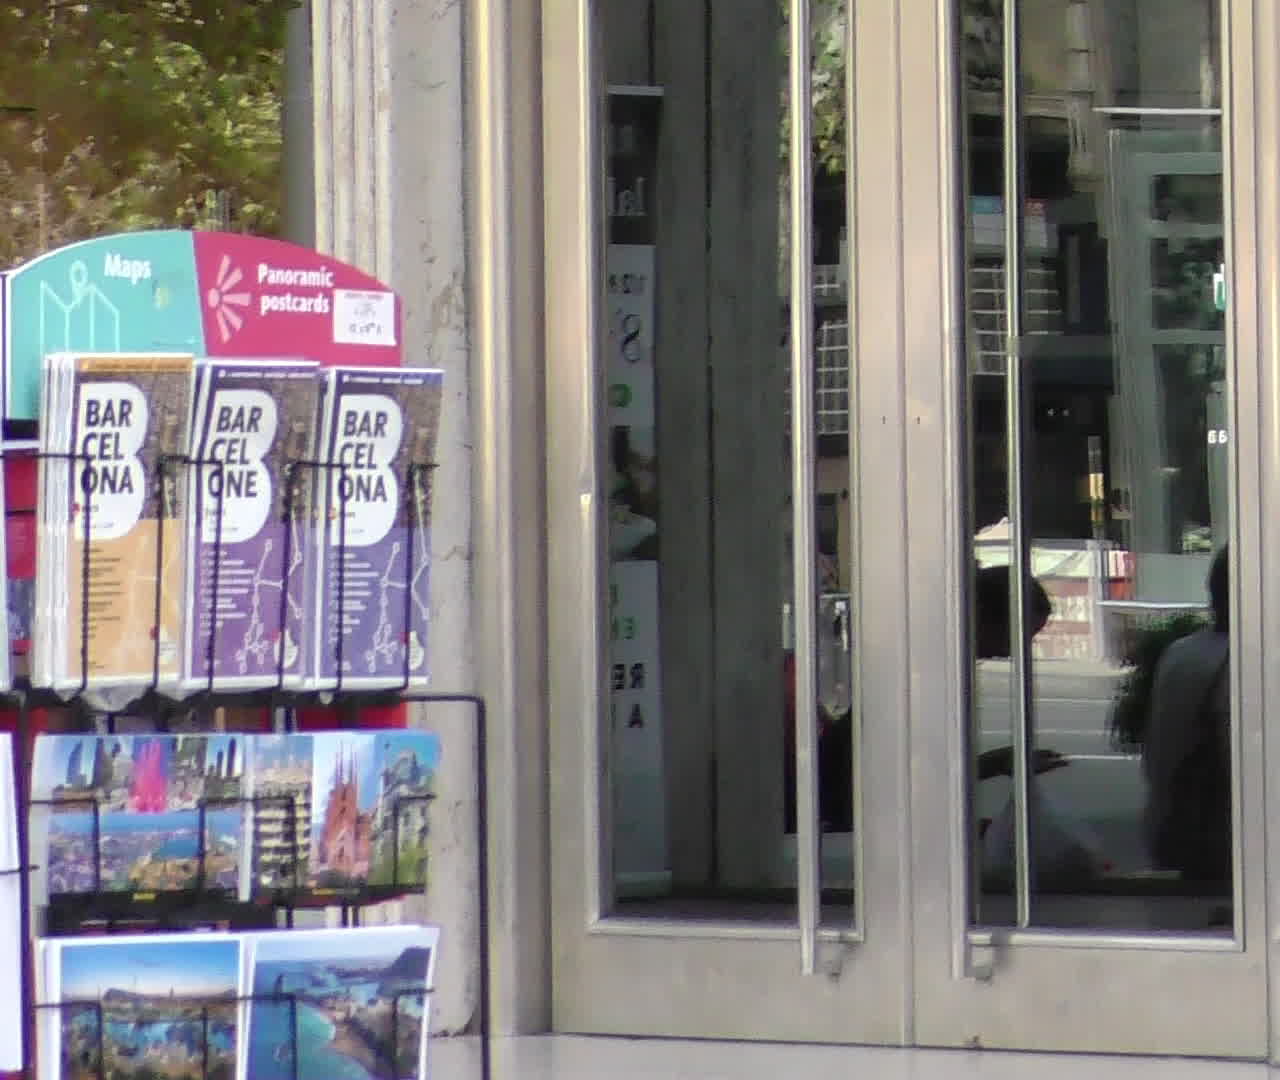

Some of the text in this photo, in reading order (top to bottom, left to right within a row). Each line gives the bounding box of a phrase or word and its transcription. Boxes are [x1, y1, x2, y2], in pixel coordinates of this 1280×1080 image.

[103, 252, 152, 285] Maps
[257, 263, 334, 288] Panoramic
[260, 293, 329, 316] postcards
[85, 399, 133, 428] BAR
[216, 405, 263, 433] BAR
[343, 410, 388, 438] BAR
[82, 431, 125, 461] CEL
[210, 437, 251, 465] CEL
[340, 442, 377, 470] CEL
[81, 466, 134, 495] ONA
[207, 470, 258, 499] ONE
[338, 475, 388, 503] ONA
